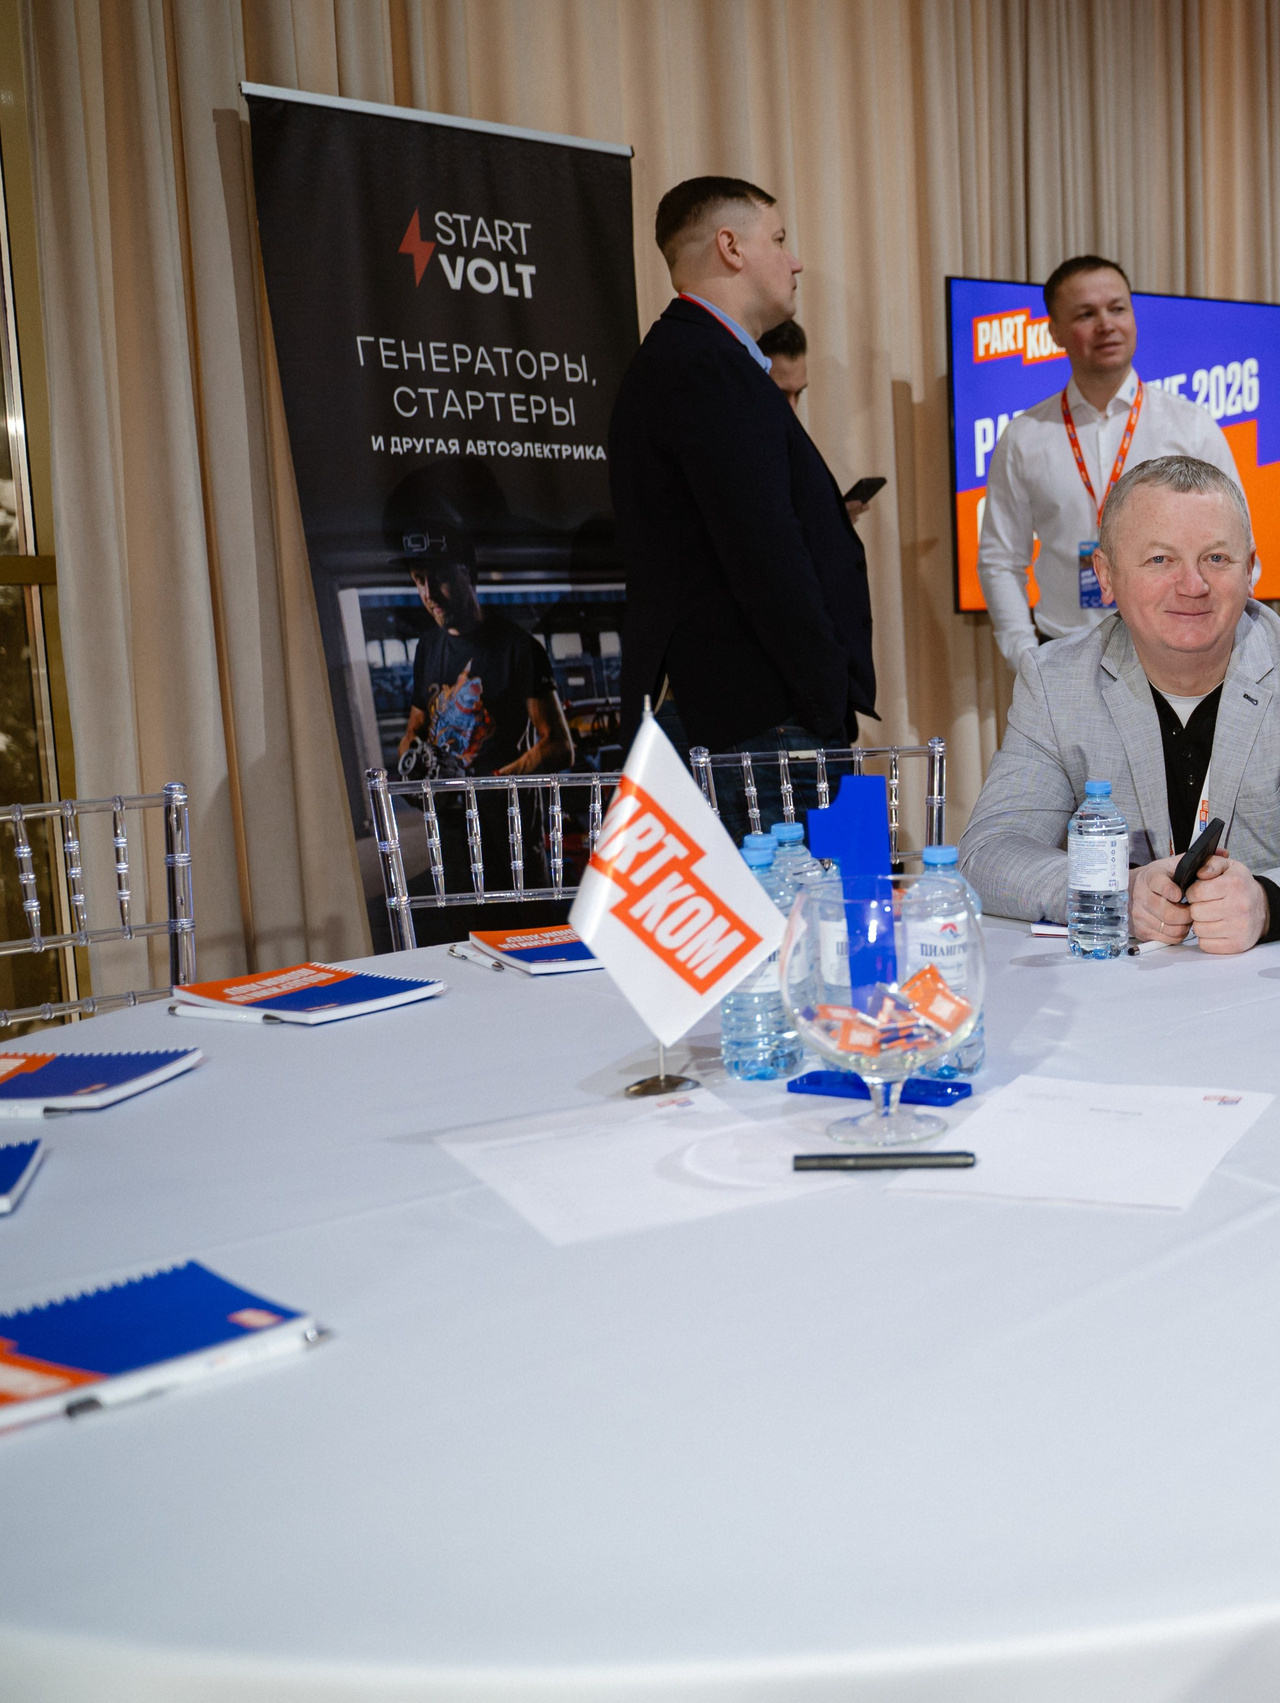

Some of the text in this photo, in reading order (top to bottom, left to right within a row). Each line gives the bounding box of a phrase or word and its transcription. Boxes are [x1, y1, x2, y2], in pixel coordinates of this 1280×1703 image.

[434, 211, 532, 255] START
[438, 253, 536, 299] VOLT
[977, 314, 1066, 359] PART KO
[356, 336, 597, 386] ГЕНЕРАТОРЫ,
[393, 386, 576, 426] СТАРТЕРЫ
[1192, 357, 1260, 420] 2026
[371, 435, 607, 461] И ДРУГАЯ АВТОЭЛЕКТРИКА
[597, 795, 690, 887] ART
[628, 871, 746, 980] KOM
